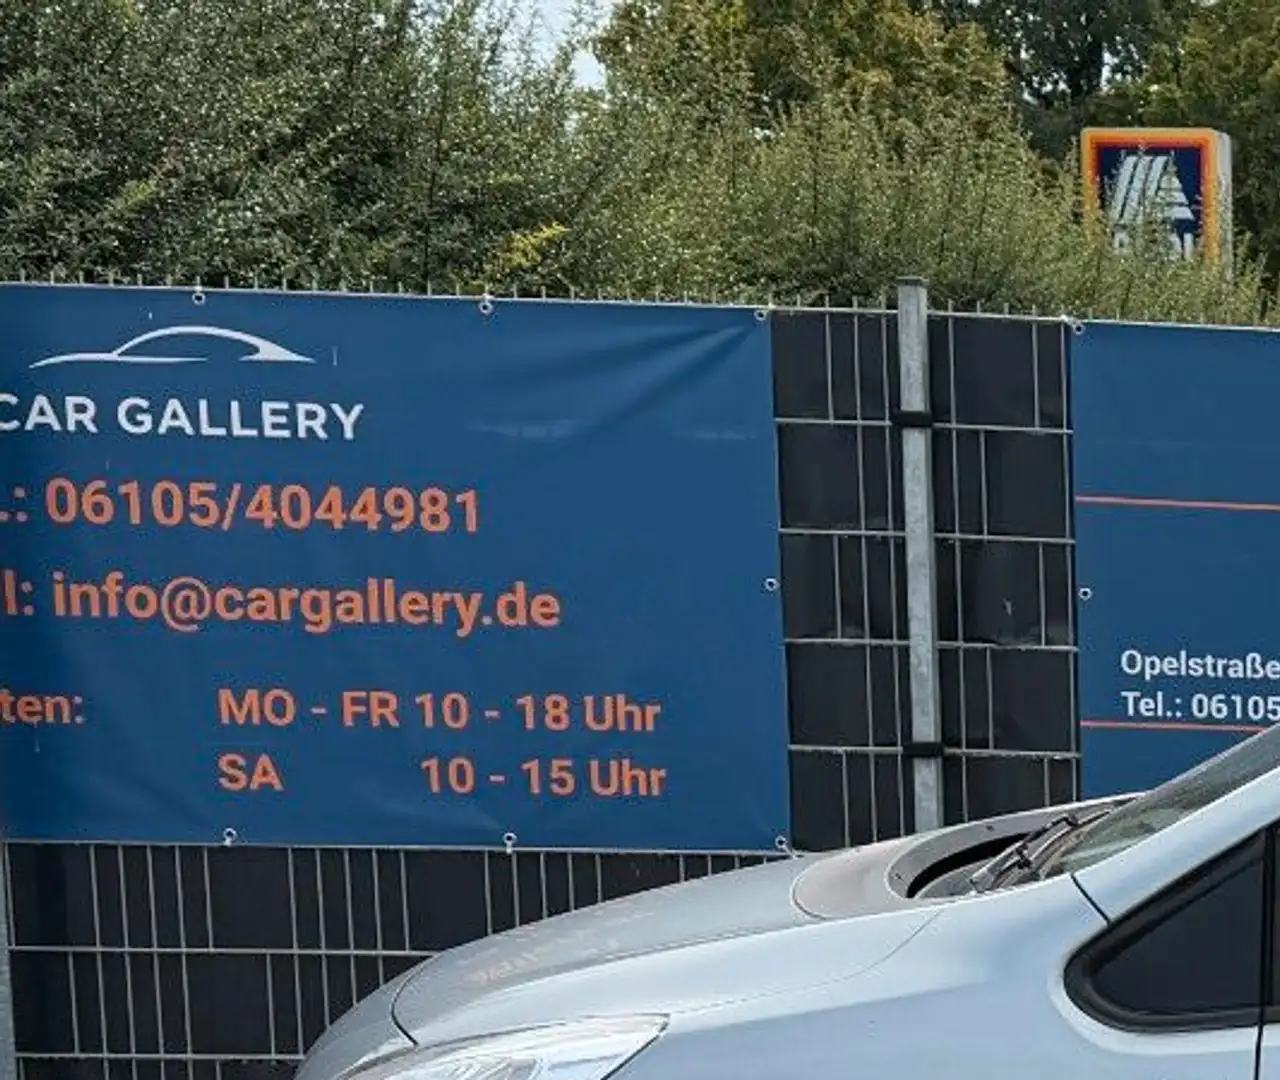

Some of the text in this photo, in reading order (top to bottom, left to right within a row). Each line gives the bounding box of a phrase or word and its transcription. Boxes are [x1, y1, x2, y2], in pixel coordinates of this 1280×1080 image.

[0, 393, 364, 440] CAR GALLERY
[45, 477, 478, 533] 06105/4044981
[52, 570, 561, 638] info@cargallery.de
[218, 688, 296, 727] MO
[342, 691, 399, 728] FR
[415, 692, 468, 729] 10
[516, 694, 569, 730] 18
[584, 694, 661, 731] Uhr
[1121, 691, 1182, 717] Tel.:
[217, 753, 284, 791] SA
[420, 756, 475, 794] 10
[521, 757, 576, 795] 15
[588, 758, 666, 796] Uhr
